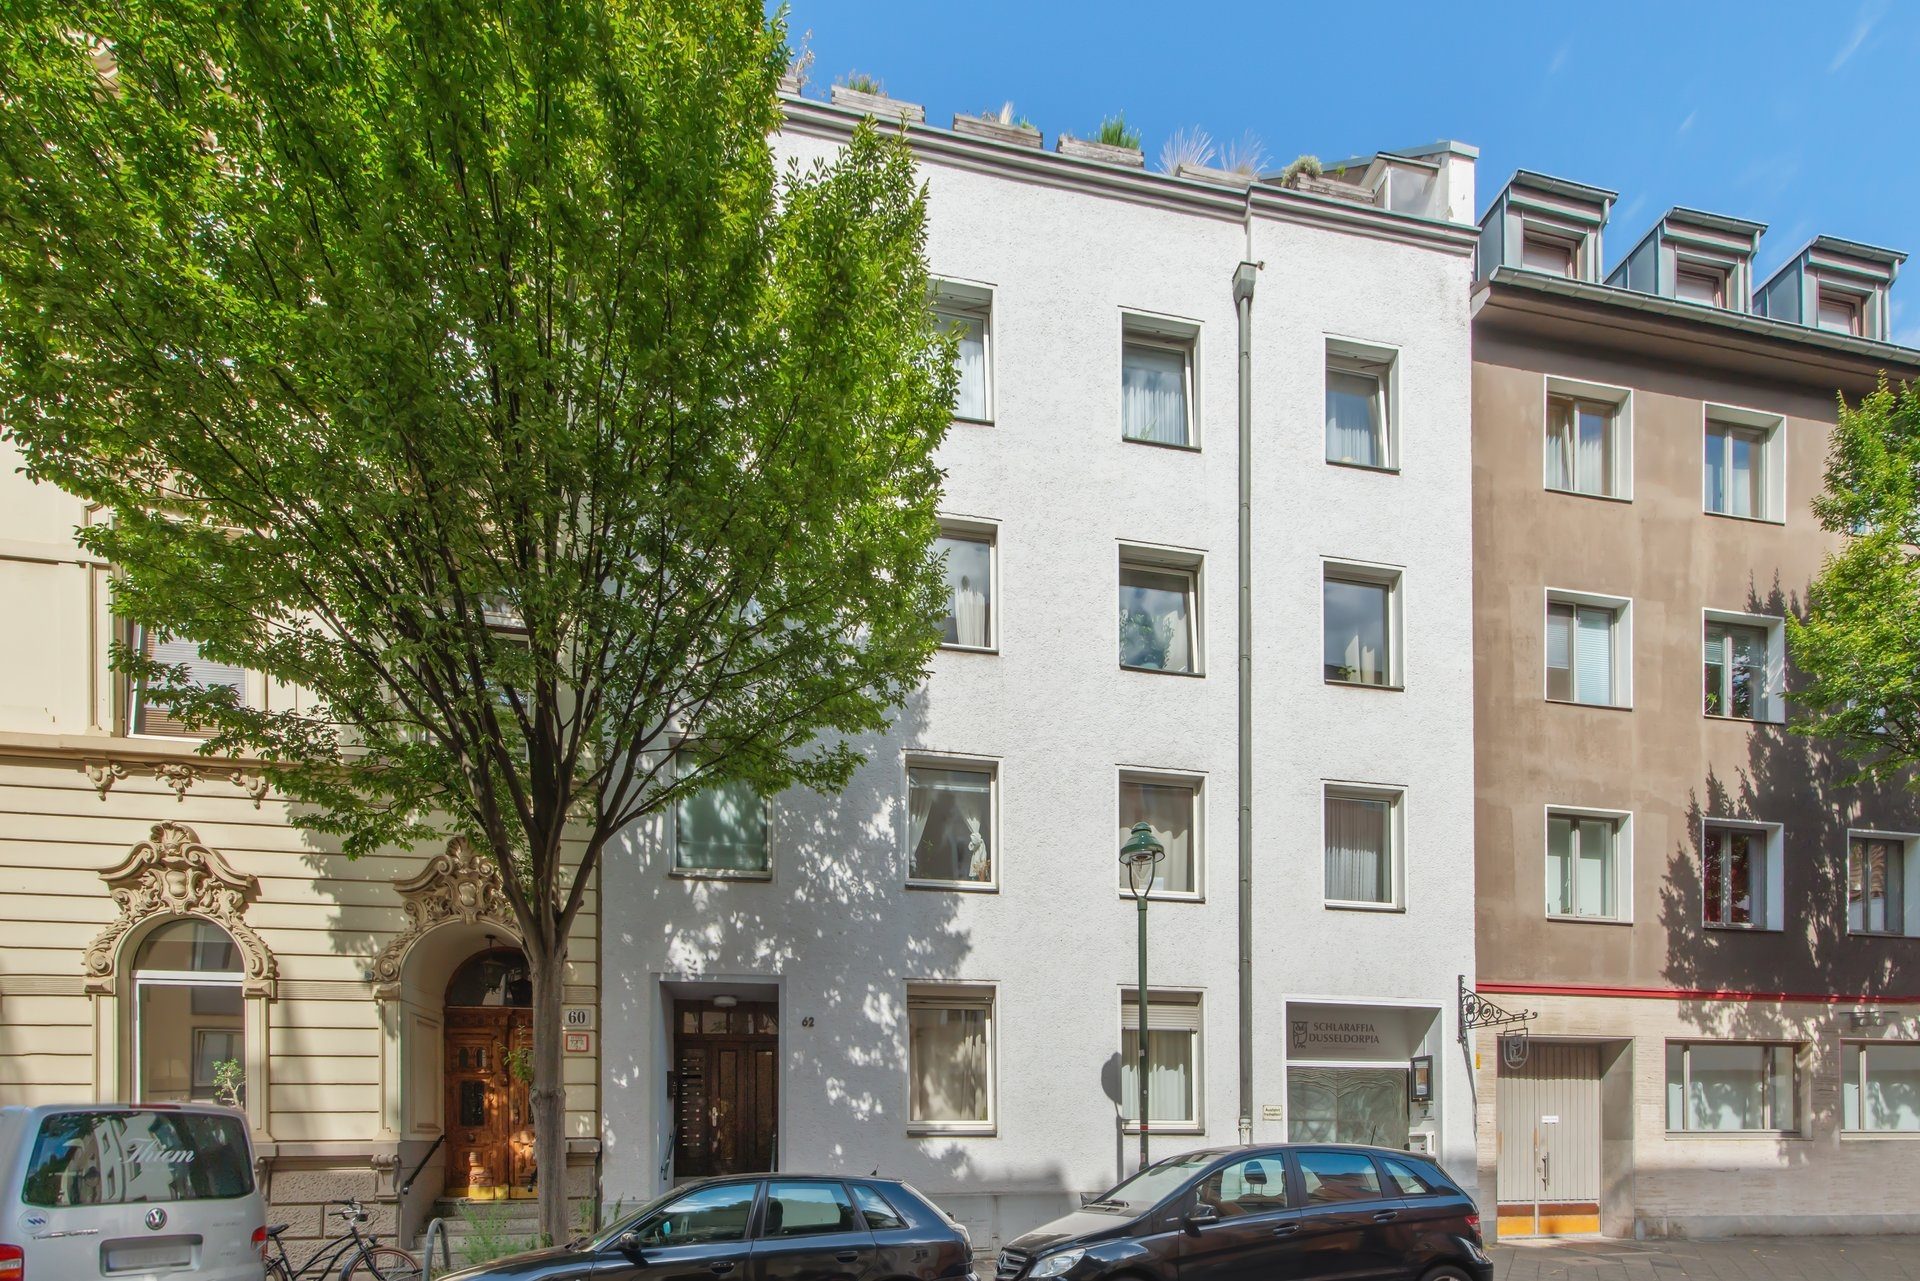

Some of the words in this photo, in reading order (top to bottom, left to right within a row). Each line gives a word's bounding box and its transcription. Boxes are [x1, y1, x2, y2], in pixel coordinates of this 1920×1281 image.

[568, 1010, 586, 1024] 60
[801, 1016, 815, 1027] 62
[1313, 1022, 1375, 1032] SCHLARAFFIA
[1309, 1033, 1380, 1043] DUSSELDORPIA
[121, 1138, 195, 1163] Thiem
